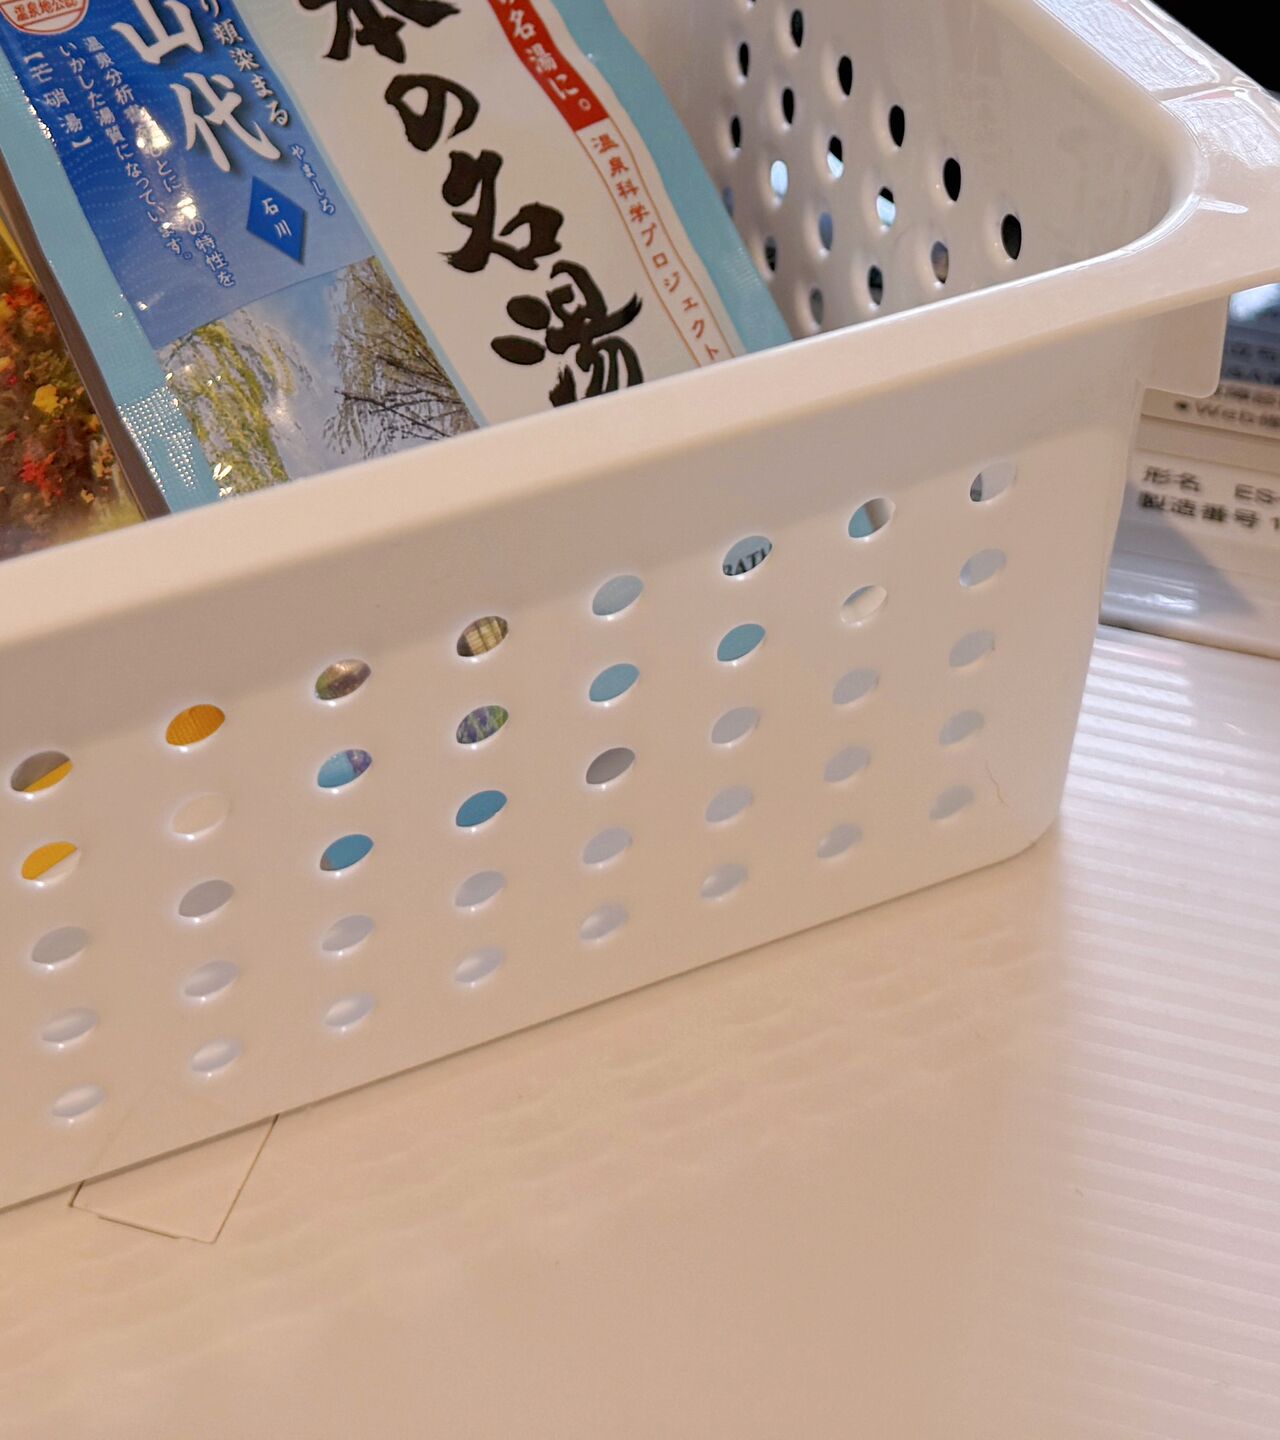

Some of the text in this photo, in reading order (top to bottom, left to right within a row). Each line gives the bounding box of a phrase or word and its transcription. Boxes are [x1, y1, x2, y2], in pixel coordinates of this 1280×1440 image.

[261, 197, 294, 239] 石川
[591, 133, 719, 361] 温泉科学プロジェクト
[1143, 465, 1202, 493] 形名
[1138, 490, 1259, 528] 製造番号
